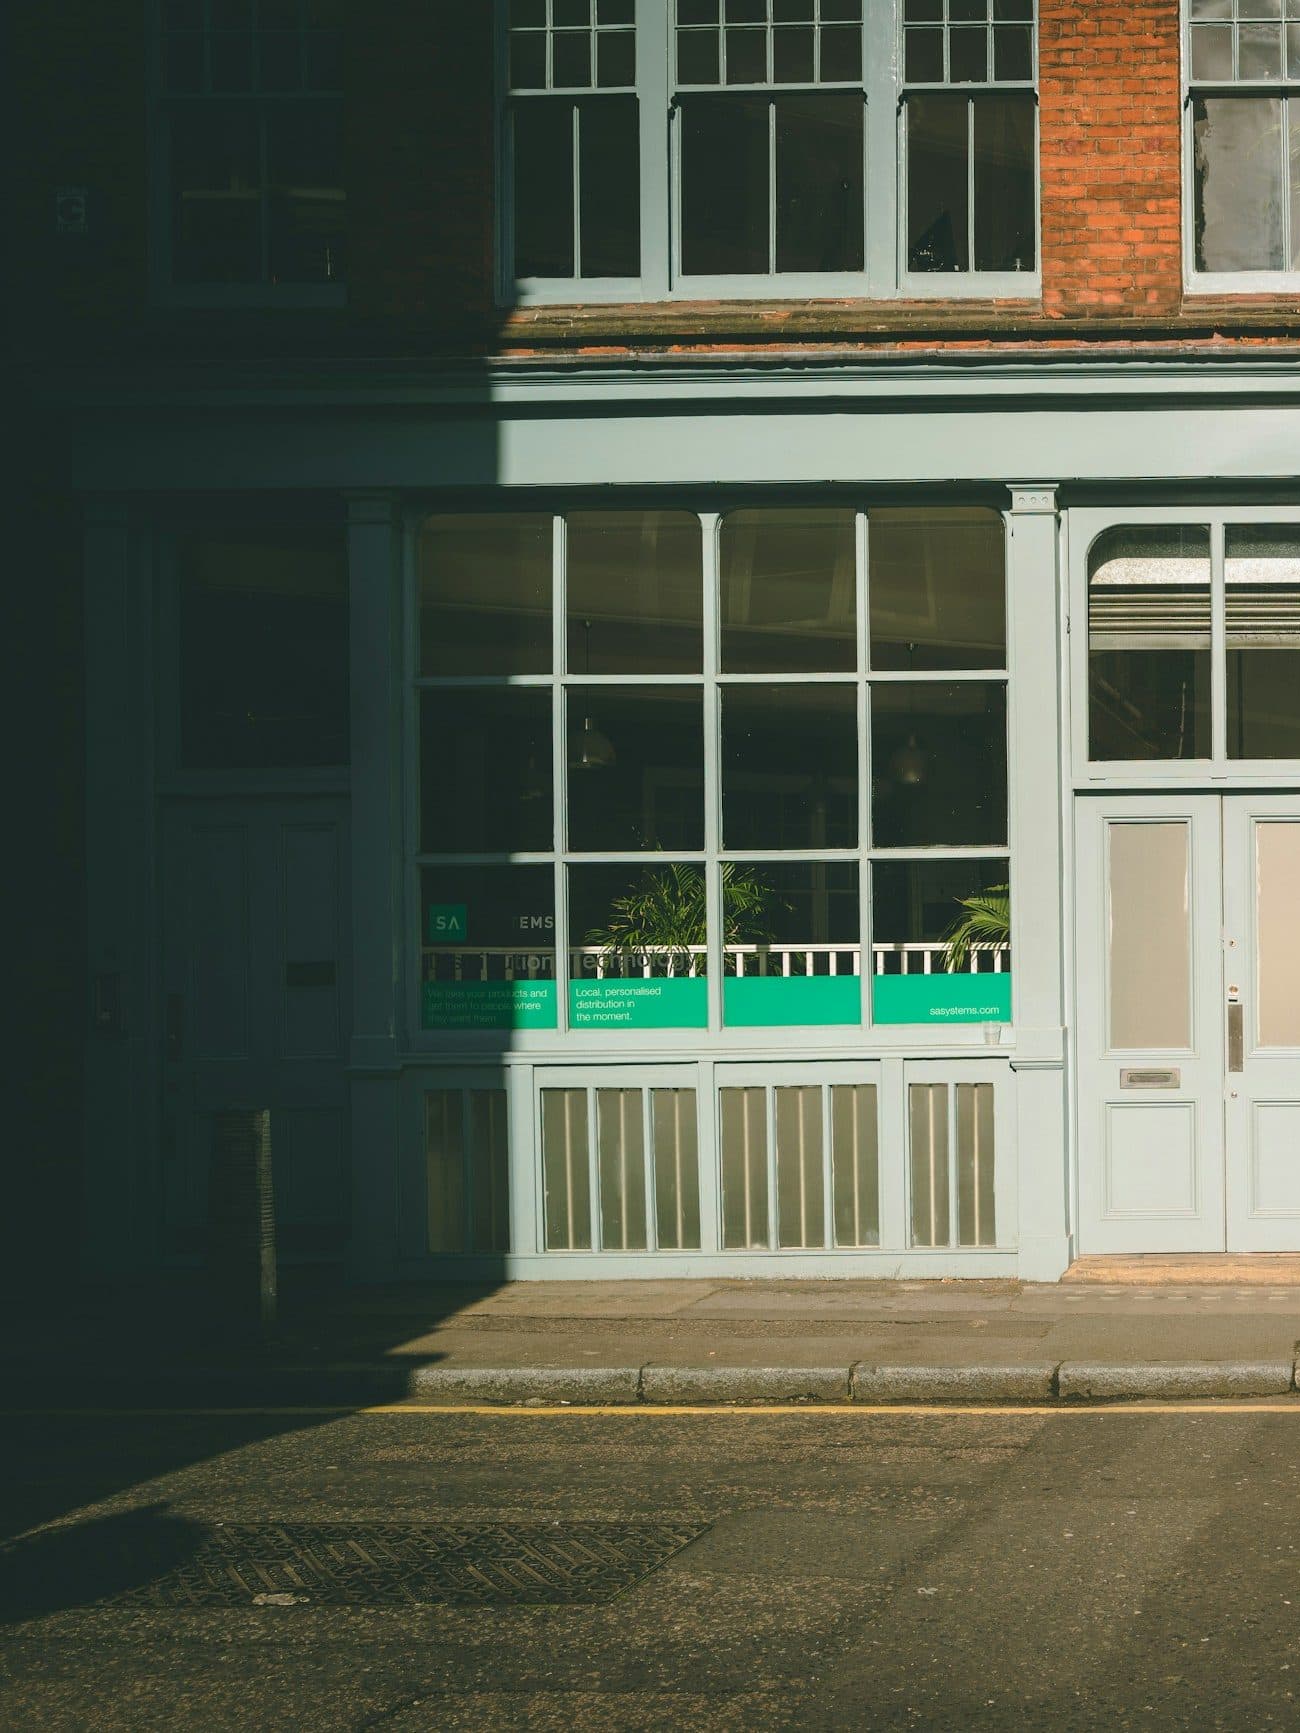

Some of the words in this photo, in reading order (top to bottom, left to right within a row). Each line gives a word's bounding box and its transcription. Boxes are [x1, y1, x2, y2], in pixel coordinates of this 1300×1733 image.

[530, 988, 548, 998] and
[605, 986, 662, 999] personalised
[514, 1001, 541, 1010] where
[576, 1000, 625, 1009] distribution
[627, 1000, 636, 1008] in
[576, 1012, 591, 1021] the
[593, 1011, 633, 1021] moment.
[929, 1006, 1000, 1017] sasystems.com
